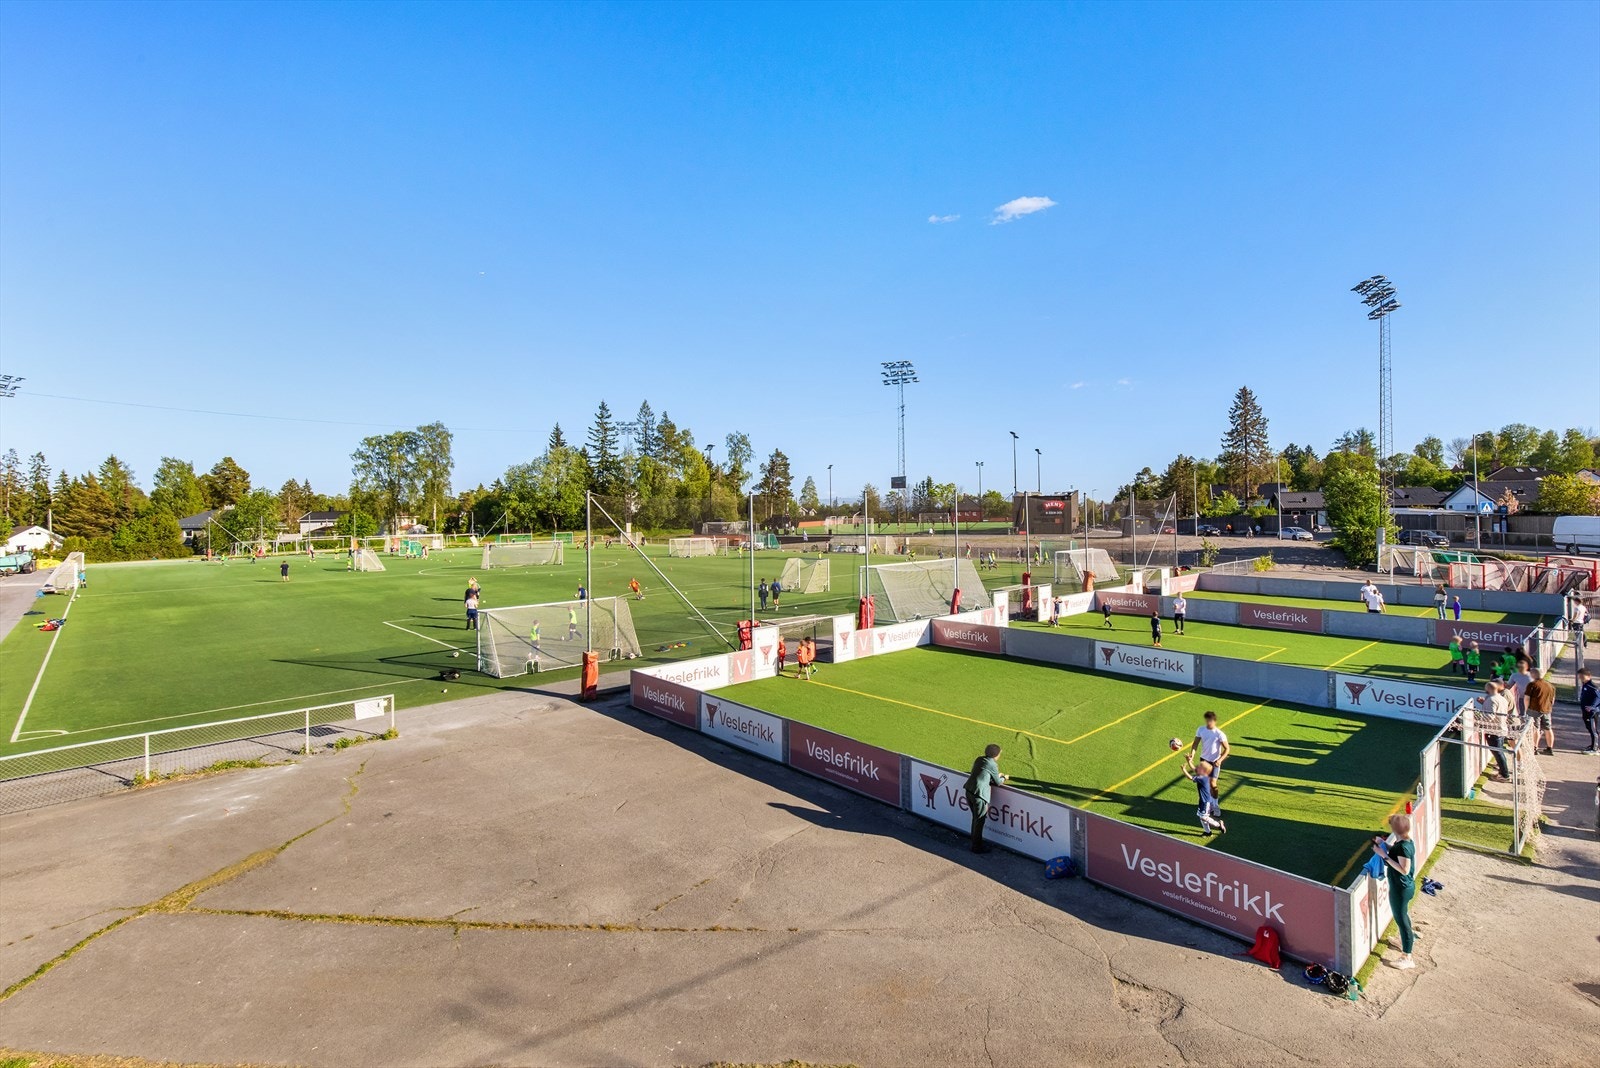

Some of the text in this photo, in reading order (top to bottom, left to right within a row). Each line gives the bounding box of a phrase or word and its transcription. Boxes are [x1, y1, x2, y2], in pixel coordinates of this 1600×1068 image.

[1105, 597, 1149, 609] Veslefrikk
[1253, 609, 1308, 624] Veslefrikk
[943, 627, 989, 643] Veslefrikk
[737, 658, 748, 675] V
[1117, 651, 1184, 673] Veslefrikk
[642, 685, 685, 711] Veslefrikk
[1371, 687, 1465, 714] Veslefrik
[719, 710, 774, 743] Veslefrikk
[806, 739, 879, 780] Veslefrikk
[945, 785, 1053, 841] Veefrikk
[1120, 843, 1286, 924] Veslefrikk
[1162, 890, 1237, 921] veslefrikkeiendom.no
